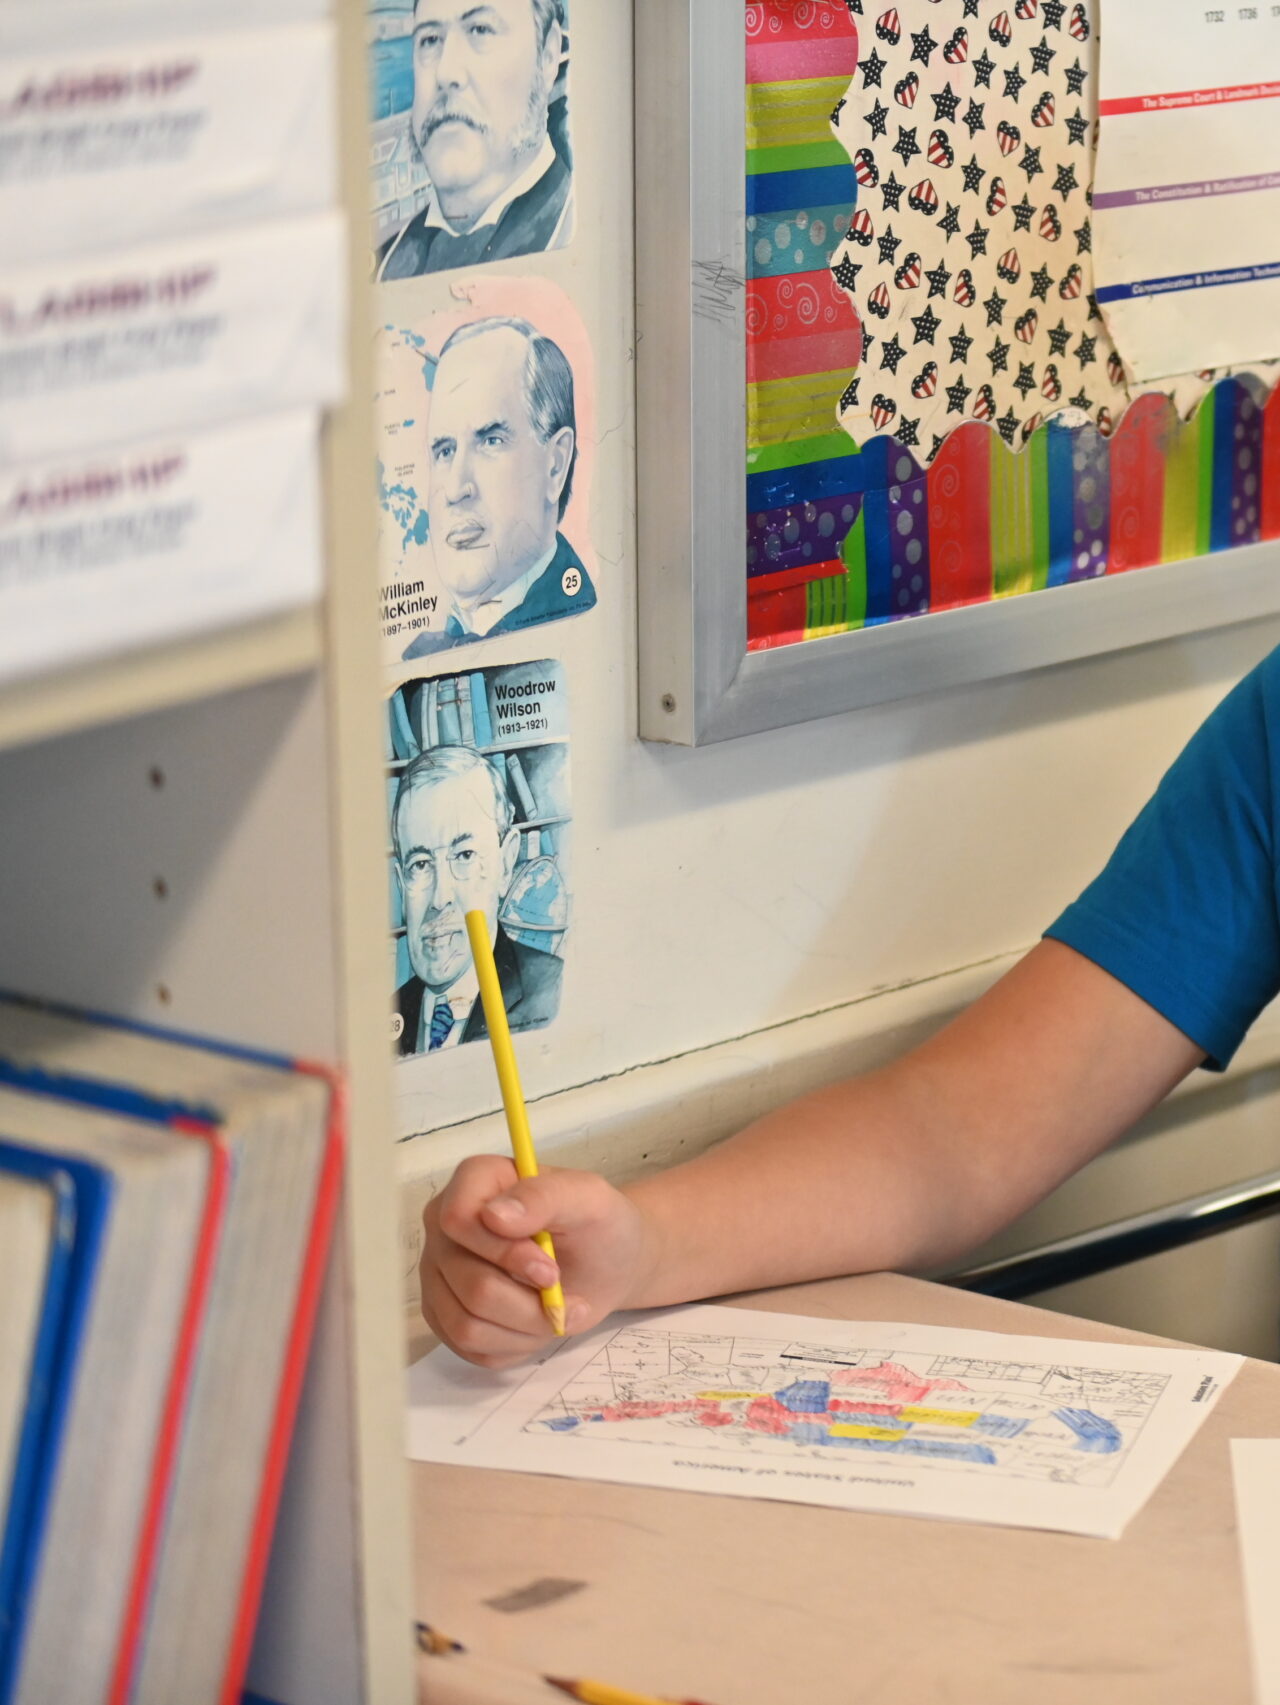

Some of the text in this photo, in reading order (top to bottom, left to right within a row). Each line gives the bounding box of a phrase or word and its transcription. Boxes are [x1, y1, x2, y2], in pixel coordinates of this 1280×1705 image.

[1204, 10, 1225, 23] 1732
[1142, 98, 1157, 108] The
[1158, 95, 1193, 107] Supreme
[1194, 92, 1215, 103] Court
[1135, 190, 1150, 202] The
[1152, 186, 1203, 199] Constitution
[1132, 278, 1195, 295] Communication
[1195, 275, 1203, 285] &
[1204, 271, 1253, 284] Information
[377, 580, 424, 602] William
[565, 574, 578, 589] 25
[378, 595, 438, 622] McKinley
[380, 615, 430, 638] 1897–1901)
[495, 680, 556, 701] Woodrow
[496, 701, 541, 719] Wilson
[497, 718, 548, 738] (1913–1921)
